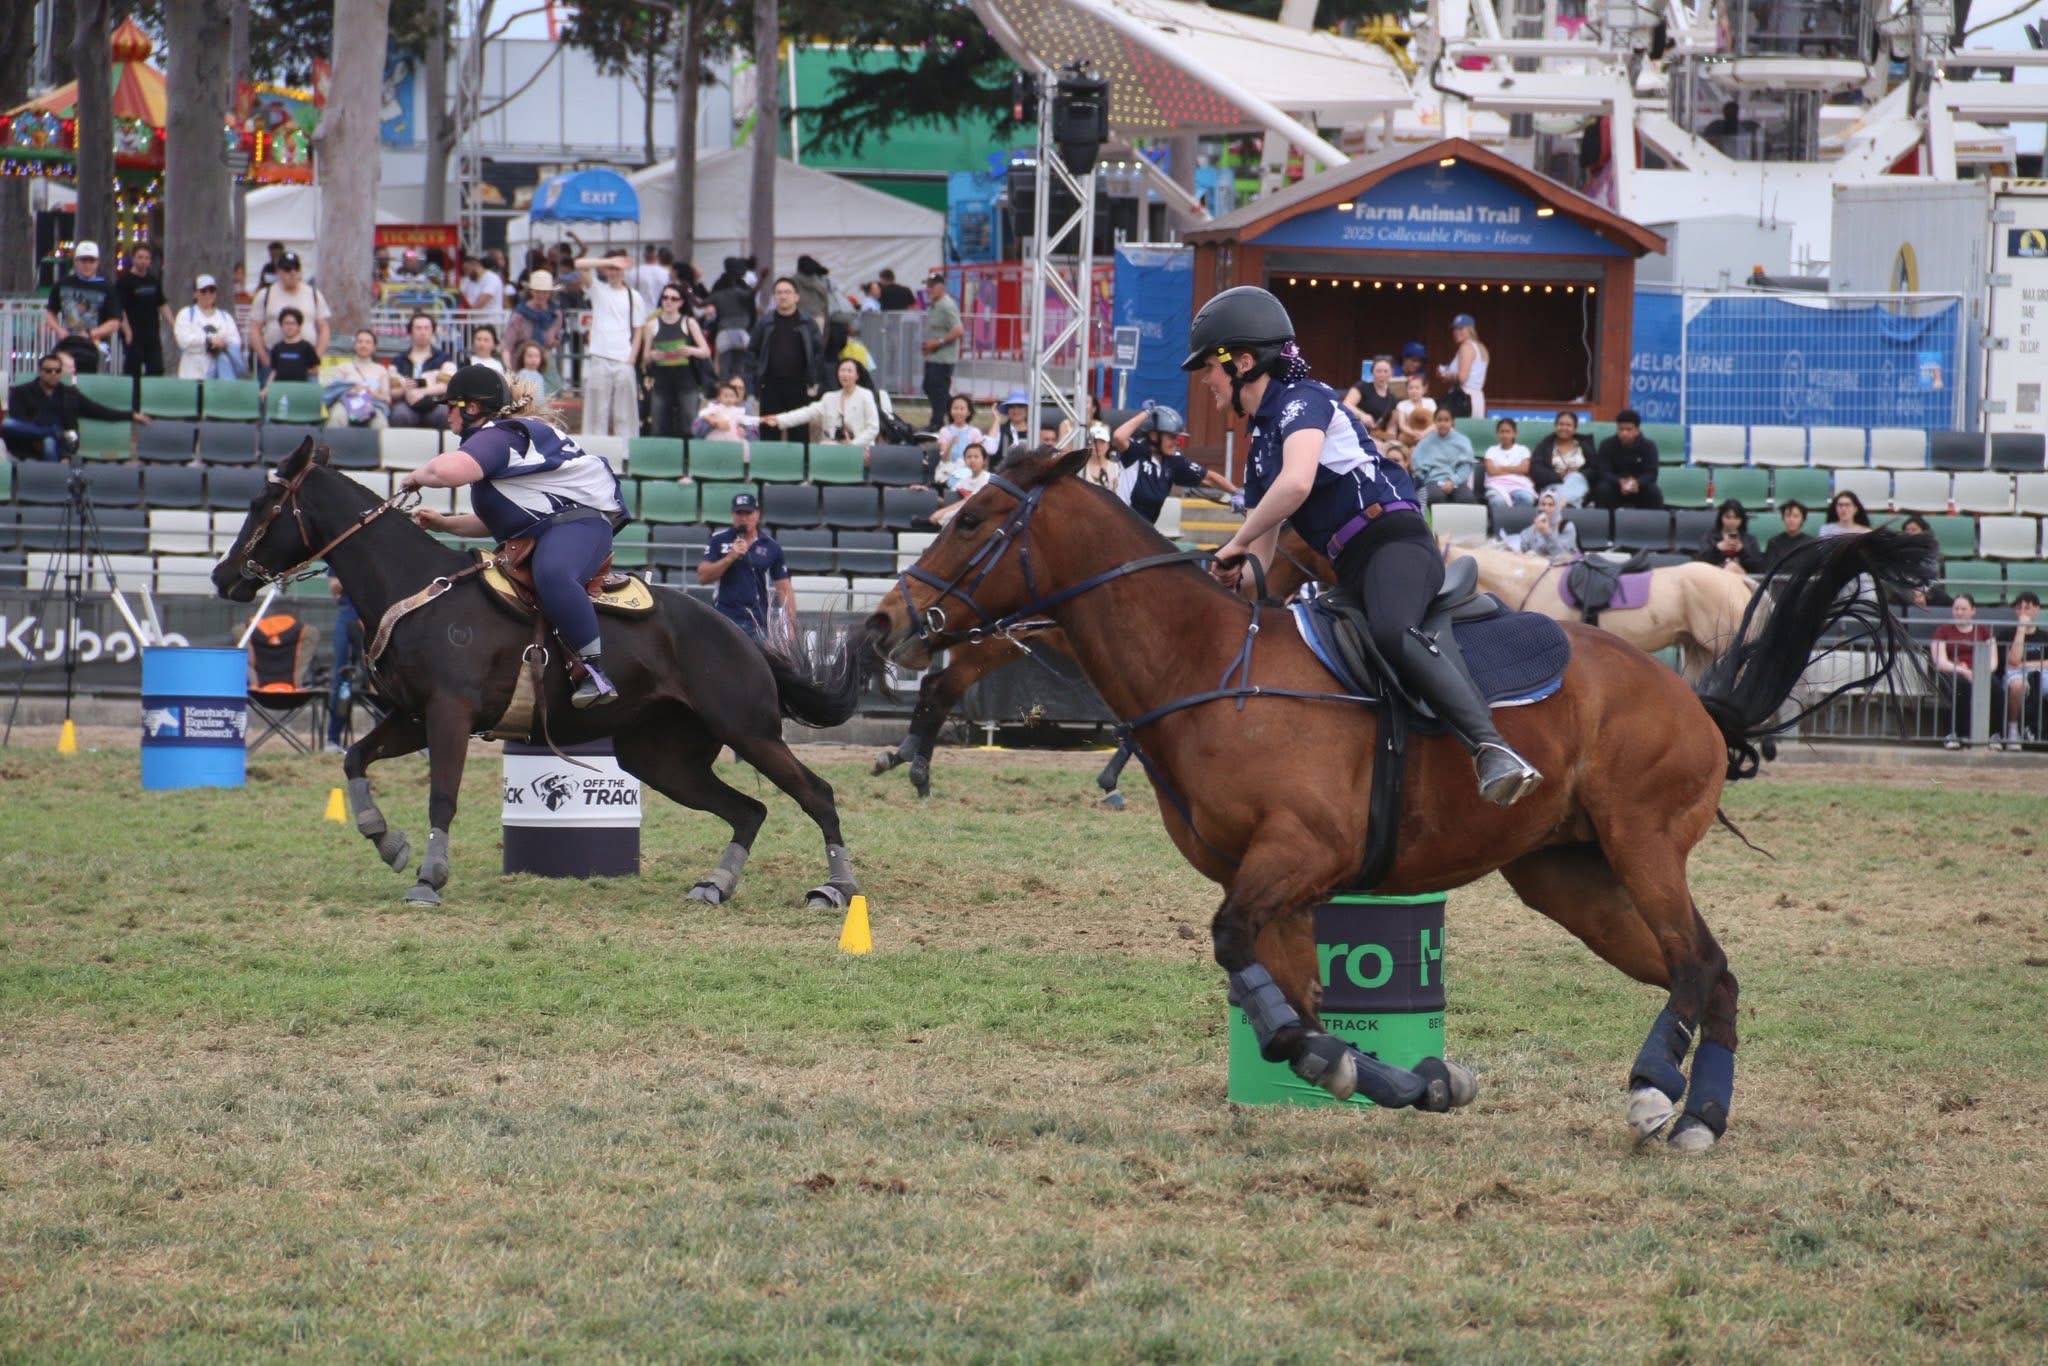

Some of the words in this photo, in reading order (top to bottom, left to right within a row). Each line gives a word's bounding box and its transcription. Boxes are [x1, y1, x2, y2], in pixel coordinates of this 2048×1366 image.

[581, 190, 617, 205] EXIT
[1355, 203, 1404, 221] Farm
[1407, 203, 1473, 223] Animal
[1476, 206, 1520, 224] Trail
[1342, 226, 1375, 240] 2025
[1378, 226, 1450, 242] Collectable
[1453, 229, 1481, 243] Pins
[1494, 231, 1532, 244] Horse
[184, 706, 236, 721] Kentucky
[184, 717, 225, 729] Equine
[184, 727, 233, 738] Research
[583, 779, 605, 788] OFF
[608, 779, 625, 788] THE
[583, 789, 638, 805] TRACK
[1322, 1019, 1379, 1031] TRACK
